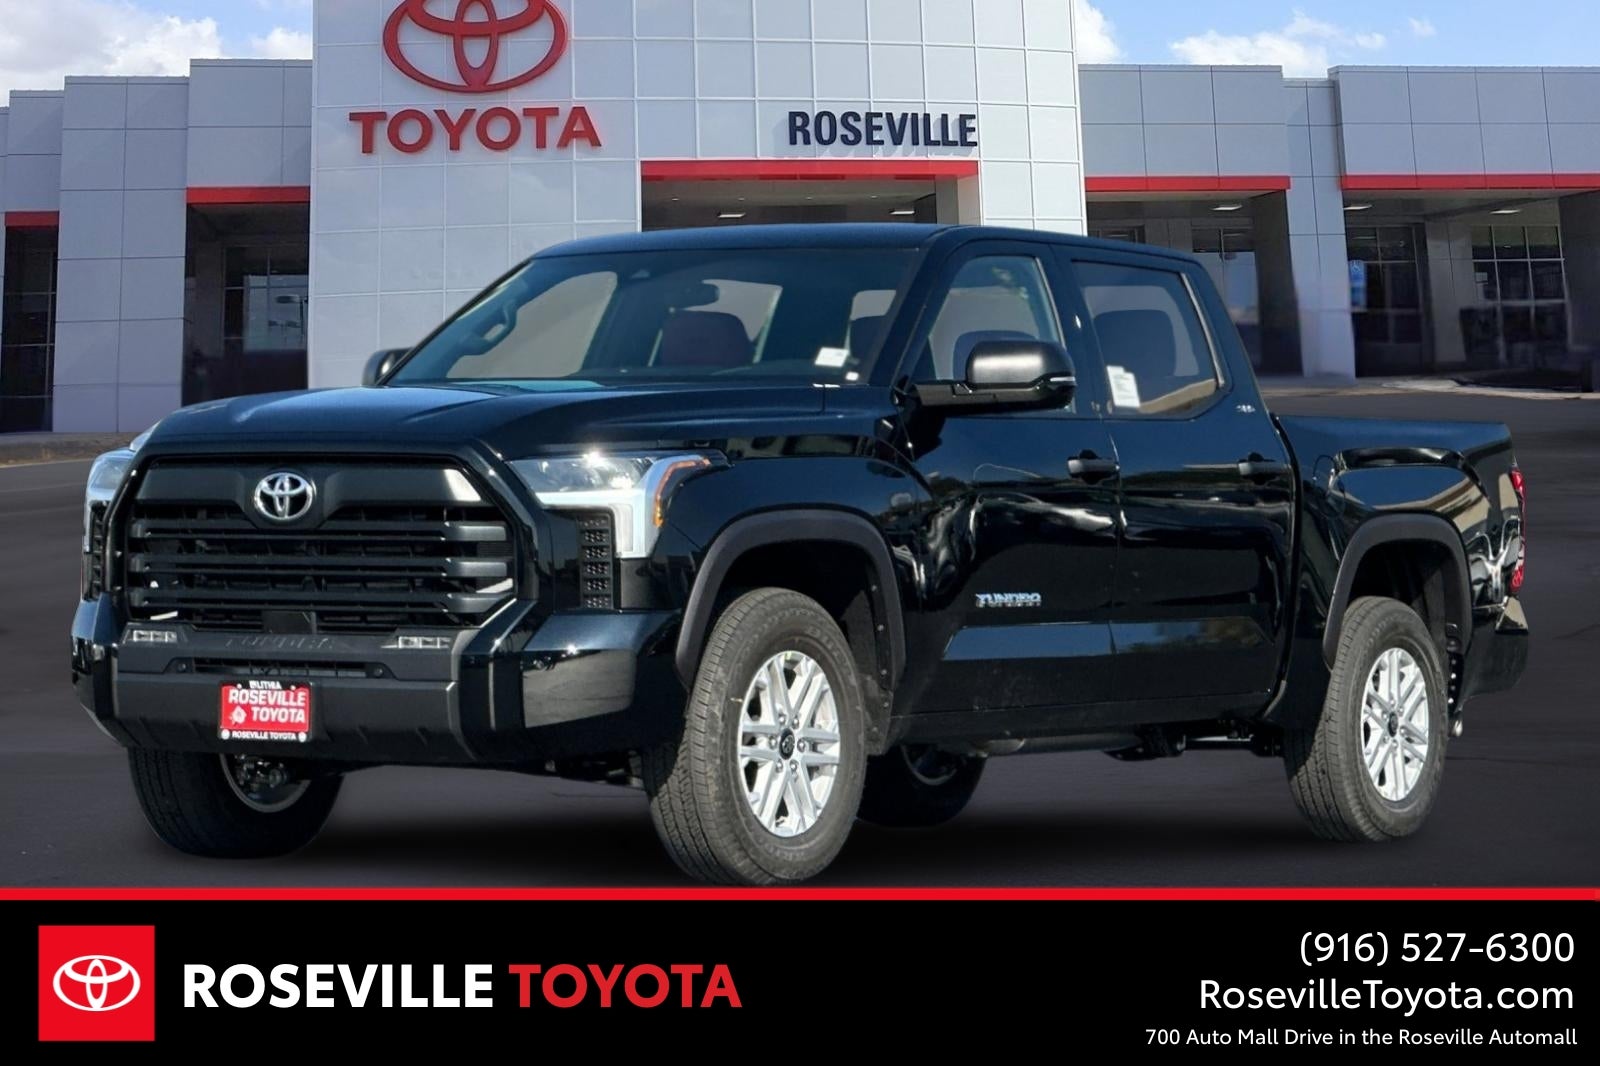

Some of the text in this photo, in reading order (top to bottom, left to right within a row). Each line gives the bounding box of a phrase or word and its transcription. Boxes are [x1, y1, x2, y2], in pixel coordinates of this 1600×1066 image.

[349, 106, 602, 154] TOYOTA
[788, 110, 979, 148] ROSEVILLE
[228, 688, 305, 706] ROSEVILLE
[251, 706, 305, 723] TOYOTA
[231, 730, 297, 740] ROSEVILLE TOYOTA
